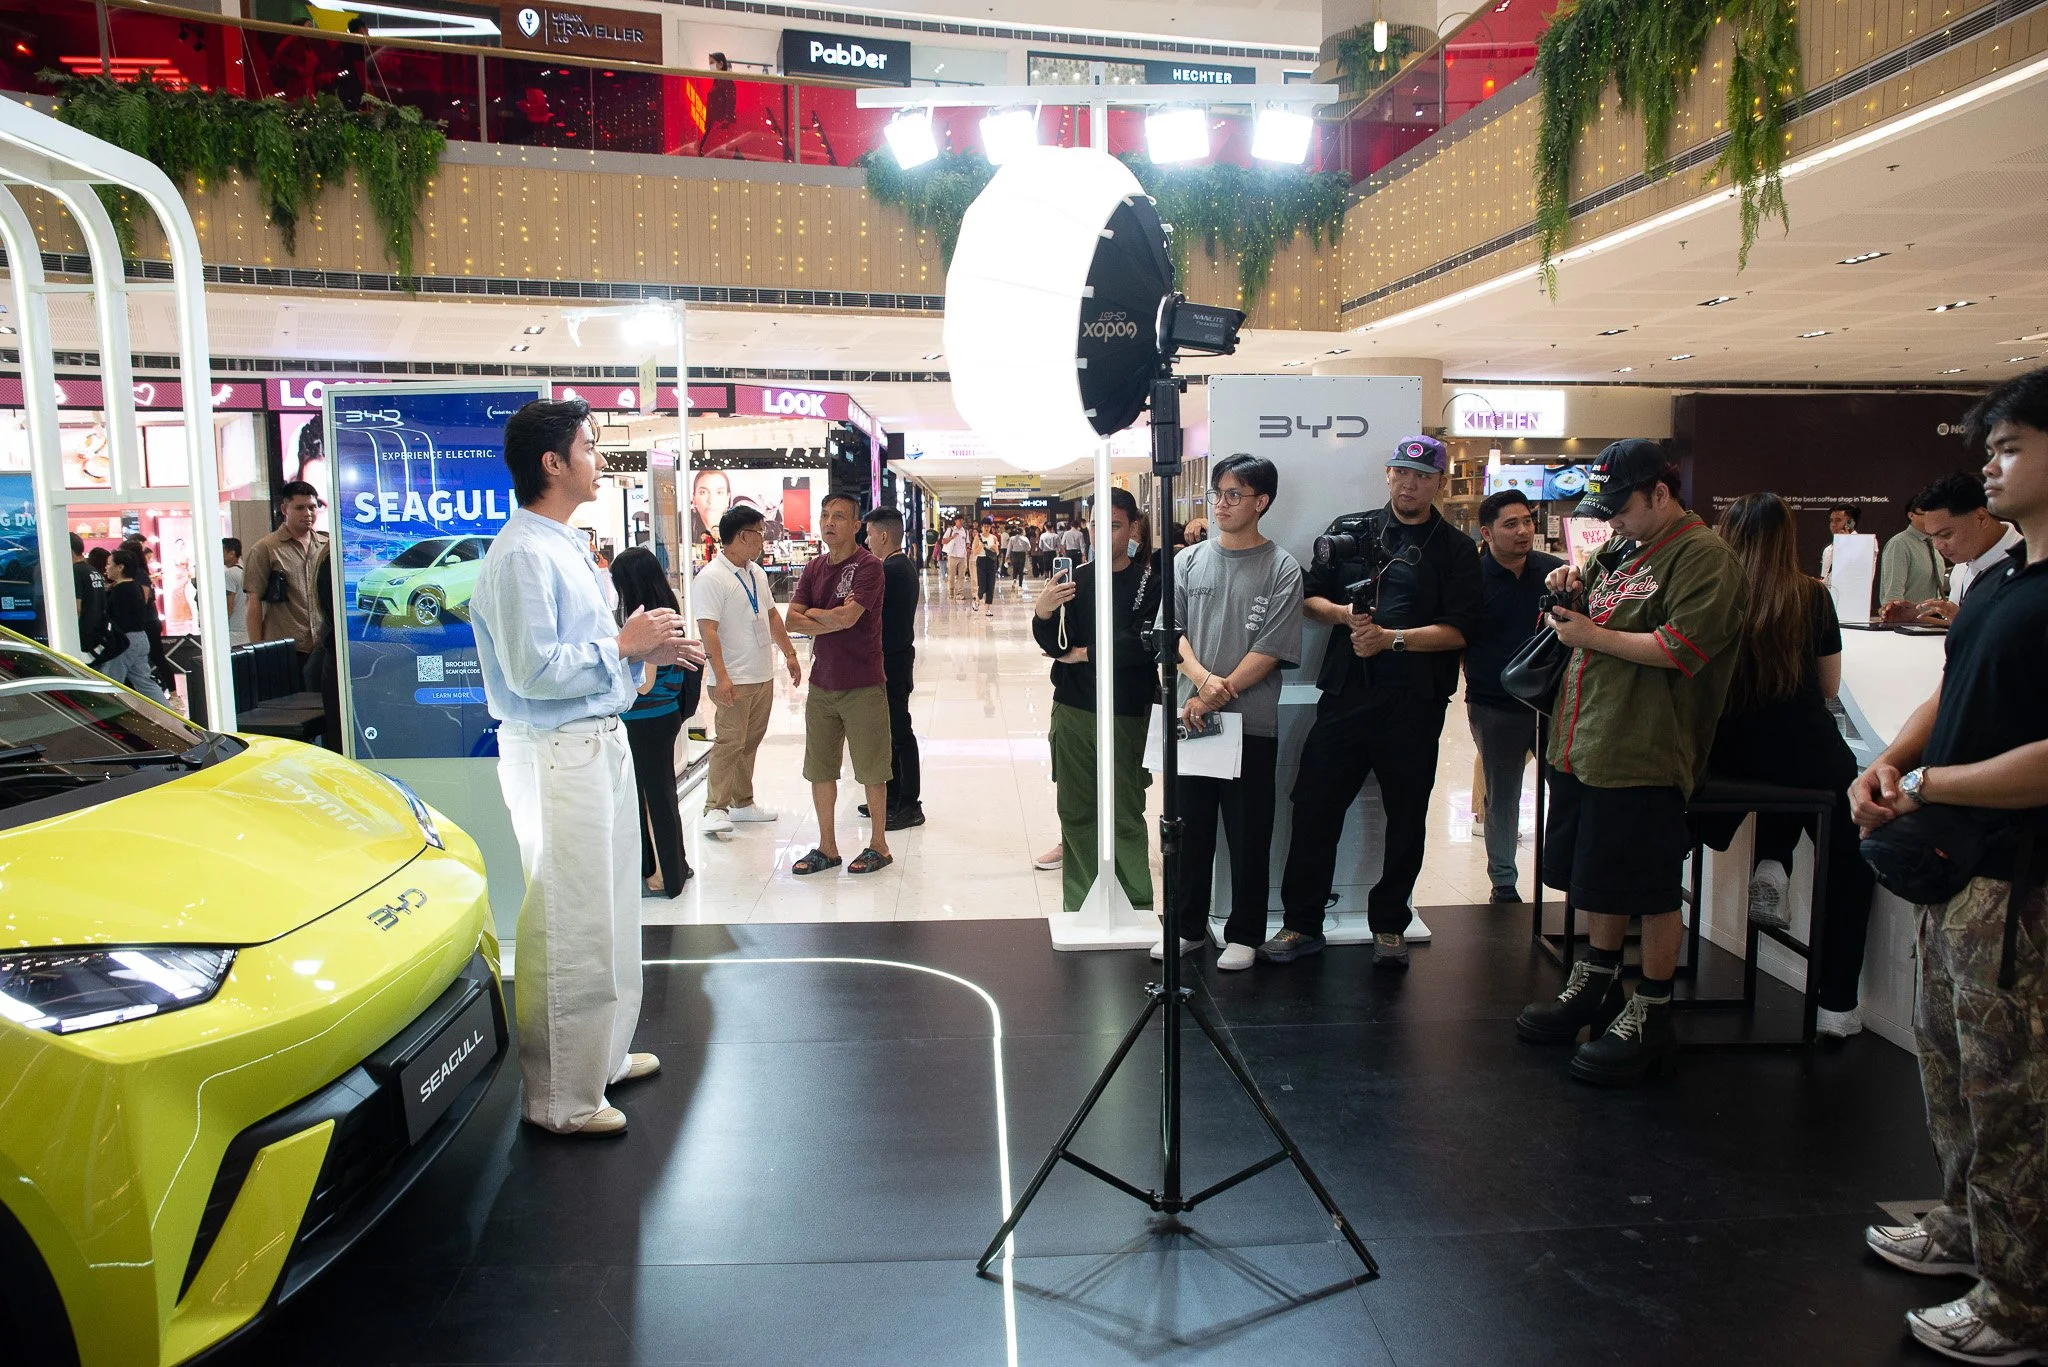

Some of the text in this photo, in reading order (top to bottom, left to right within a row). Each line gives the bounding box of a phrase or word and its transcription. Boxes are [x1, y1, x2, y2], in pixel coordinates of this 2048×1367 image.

[551, 12, 583, 23] URBAN
[552, 20, 644, 43] TRAVELLER
[810, 40, 888, 70] PabDer
[1172, 68, 1233, 84] HECHTER
[1192, 313, 1225, 324] NANLITE
[1082, 320, 1138, 343] Godox
[763, 389, 827, 418] LOOK
[345, 409, 401, 423] BYD
[1462, 410, 1543, 431] KITCHEN
[1259, 415, 1369, 438] BYD
[382, 449, 496, 461] EXPERIENCE ELECTRIC.
[1838, 496, 1854, 504] shop
[1582, 529, 1602, 538] BUY
[445, 660, 478, 668] BROCHURE
[452, 691, 470, 699] MORE
[366, 887, 428, 931] BYD
[420, 1029, 484, 1103] SEAGULL
